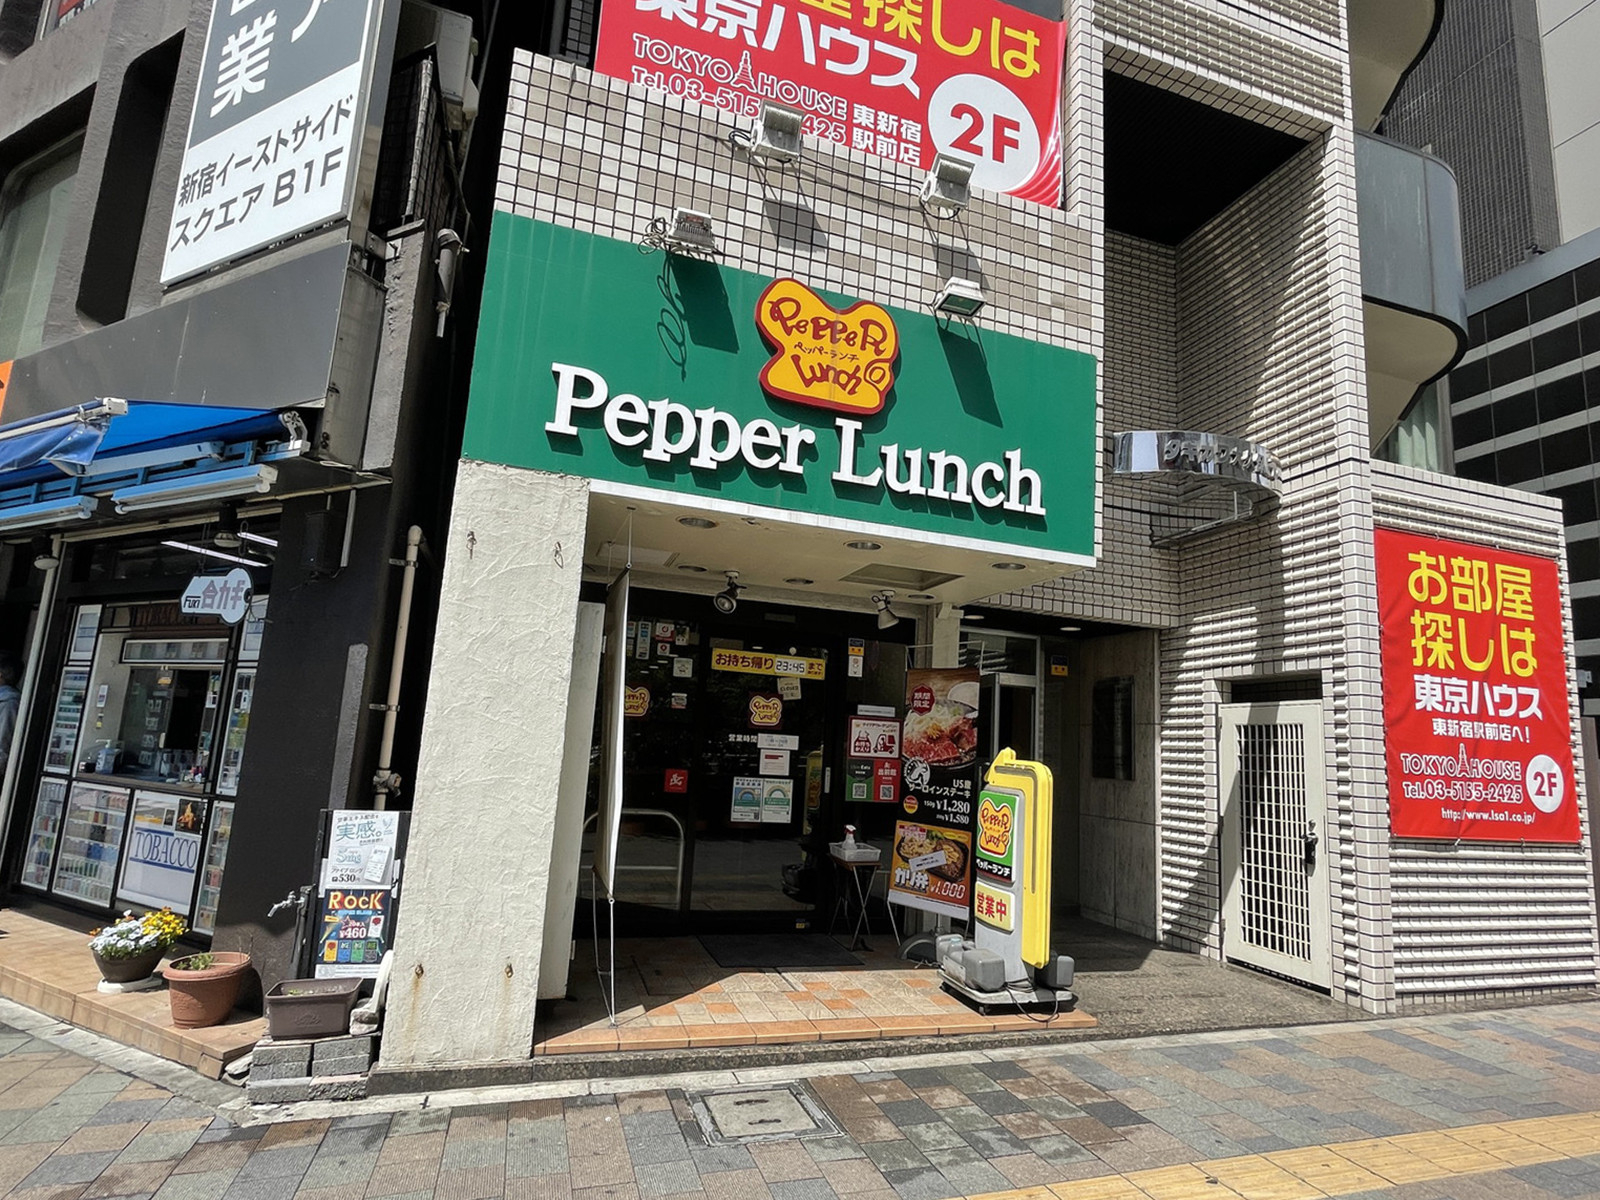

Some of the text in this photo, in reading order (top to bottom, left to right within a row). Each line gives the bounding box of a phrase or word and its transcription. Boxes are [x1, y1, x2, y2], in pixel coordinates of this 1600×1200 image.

[210, 0, 277, 118] 業
[797, 0, 1040, 78] 探しは
[633, 33, 848, 120] TOKYO HOUSE
[852, 103, 922, 144] 東新宿
[950, 103, 1020, 163] 2F
[178, 94, 353, 207] 新宿イーストサイド
[852, 127, 921, 167] 駅前店
[171, 147, 344, 252] スクエア B1F
[793, 341, 860, 363] ペッパーランチ
[545, 362, 1046, 515] Pepper Lunch
[202, 580, 246, 609] 合カギ
[1408, 550, 1535, 621] お部屋
[715, 653, 774, 670] お持ち帰り
[775, 660, 805, 673] 23:45
[808, 662, 823, 671] まで
[1410, 609, 1537, 677] 探しは
[1413, 673, 1543, 720] 東京ハウス
[1432, 717, 1530, 743] 東新宿駅前店へ!
[1401, 753, 1521, 781] TOKYO HOUSE
[1533, 771, 1557, 797] 2F
[1403, 778, 1523, 804] Tel.03-5155-2425
[135, 832, 198, 868] TOBACCO
[336, 820, 382, 842] 実感。
[976, 858, 1011, 876] ペッパーランチ
[977, 891, 1007, 922] 営業中
